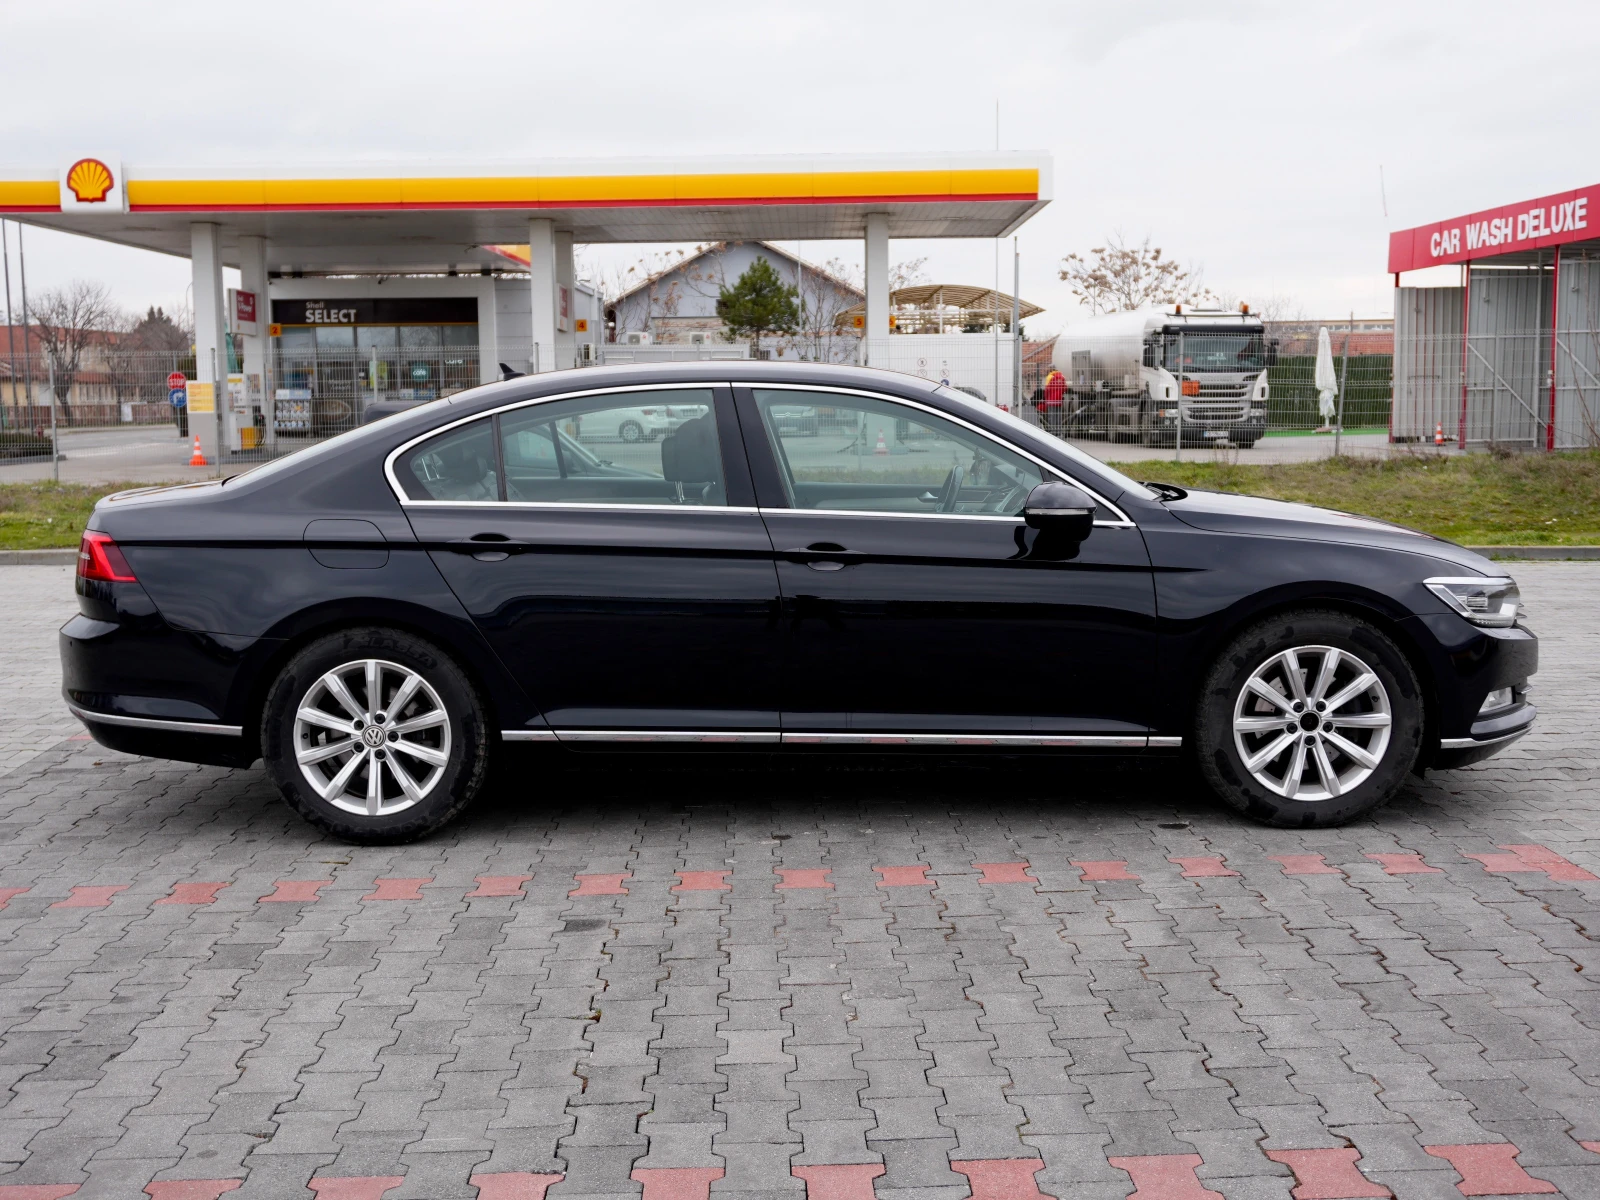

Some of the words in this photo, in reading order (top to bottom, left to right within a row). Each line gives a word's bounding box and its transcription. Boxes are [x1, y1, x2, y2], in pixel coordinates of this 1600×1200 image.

[1430, 228, 1461, 258] CAR
[1465, 216, 1514, 251] WASH
[1517, 197, 1588, 241] DELUXE
[305, 301, 324, 309] Shell
[305, 309, 356, 323] SELECT
